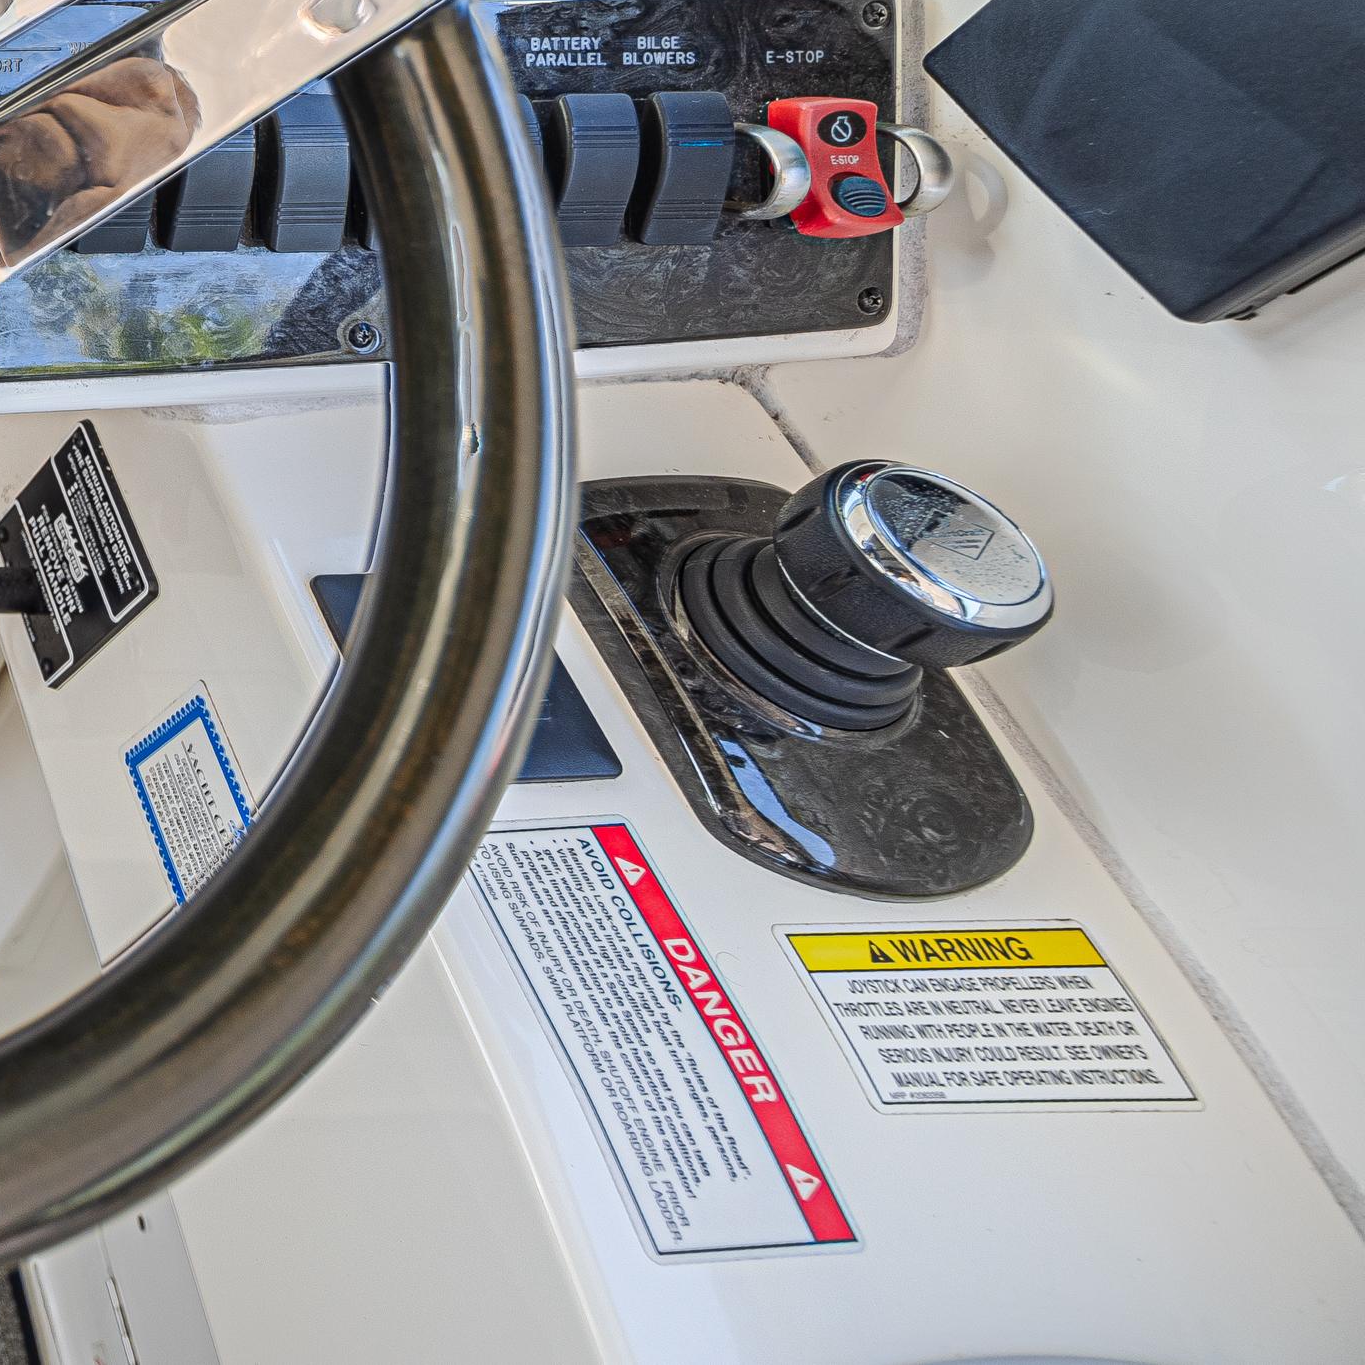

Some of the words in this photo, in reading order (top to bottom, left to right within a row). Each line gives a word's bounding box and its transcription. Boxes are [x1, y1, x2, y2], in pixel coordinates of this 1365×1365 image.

[525, 53, 607, 67] PARALLEL
[530, 37, 602, 51] BATTERY
[622, 51, 696, 65] BLOWERS
[636, 36, 680, 50] BILGE
[766, 50, 824, 63] E-STOP
[830, 155, 860, 165] E-STOP
[34, 514, 65, 582] REMOVE
[102, 501, 131, 564] AUTOMATIC
[43, 558, 71, 625] HANDLE
[556, 848, 585, 893] Visibility
[576, 838, 615, 890] AVOID
[560, 876, 588, 919] weather
[564, 910, 598, 955] proceed
[566, 847, 596, 891] Maintain
[593, 894, 626, 942] Look-out
[631, 961, 665, 1009] required
[889, 936, 1033, 962] WARNING
[505, 842, 524, 869] Such
[552, 928, 593, 991] considered
[588, 994, 611, 1027] under
[619, 1052, 649, 1096] control
[847, 978, 904, 994] JOYSTICK
[902, 978, 931, 993] CAN
[927, 977, 981, 992] ENGAGE
[977, 975, 1057, 991] PROPELLERS
[1054, 975, 1094, 989] WHEN
[487, 862, 512, 899] USING
[542, 966, 567, 1000] SWIM
[612, 1101, 653, 1177] BOARDING
[663, 937, 777, 1103] DANGER
[833, 1001, 904, 1017] THROTTLES
[903, 1000, 931, 1016] ARE
[999, 998, 1041, 1014] NEVER
[1043, 997, 1082, 1013] LEAVE
[1078, 997, 1134, 1013] ENGINES
[488, 843, 513, 878] AVOID
[508, 881, 530, 908] RISK
[525, 910, 541, 928] OF
[536, 931, 566, 974] INJURY
[561, 977, 578, 997] OR
[599, 1050, 639, 1113] SHUTOFF
[633, 1118, 665, 1171] ENGINE
[661, 1180, 690, 1227] PRIOR
[858, 1024, 916, 1040] RUNNING
[912, 1023, 947, 1039] WITH
[943, 1023, 995, 1038] PEOPLE
[1005, 1022, 1034, 1037] THE
[1075, 1021, 1115, 1036] DEATH
[1116, 1020, 1136, 1036] OR
[878, 1047, 932, 1064] SERIOUS
[931, 1047, 974, 1063] INJURY
[974, 1046, 1018, 1062] COULD
[1064, 1045, 1092, 1061] SEE
[891, 1072, 946, 1087] MANUAL
[942, 1071, 971, 1087] FOR
[969, 1070, 1005, 1086] SAFE
[1002, 1069, 1072, 1086] OPERATING
